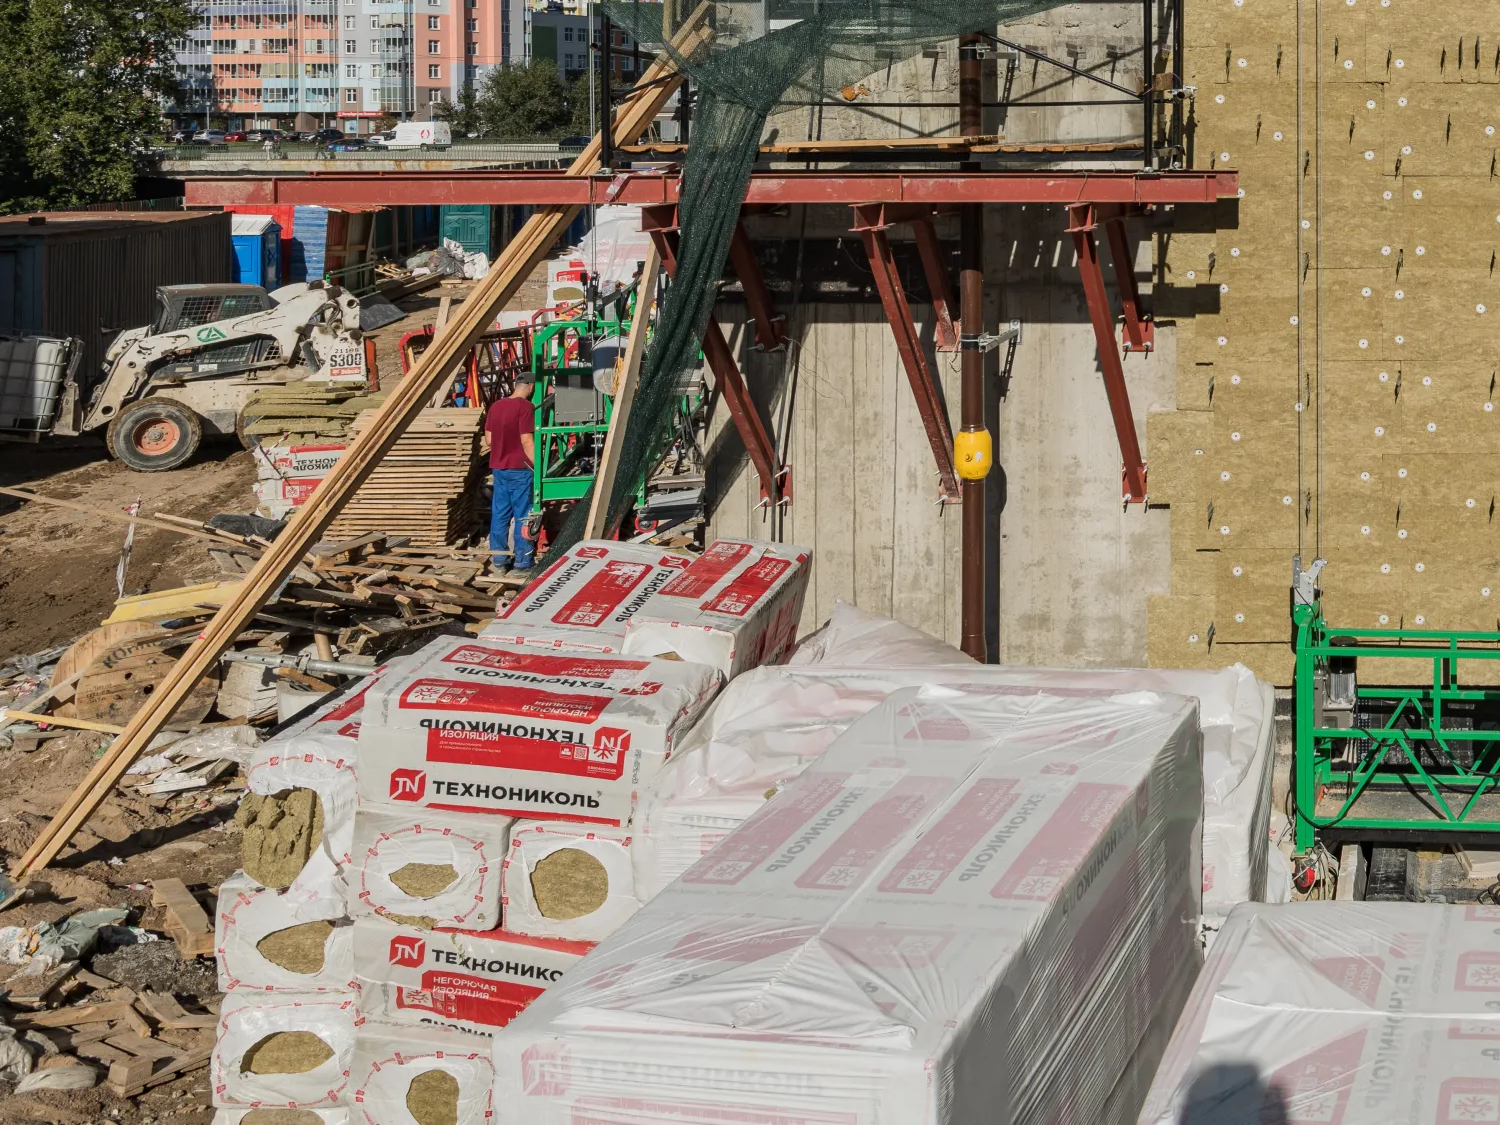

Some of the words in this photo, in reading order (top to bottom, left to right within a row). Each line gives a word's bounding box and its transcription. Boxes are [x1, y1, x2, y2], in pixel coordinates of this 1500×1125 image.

[525, 559, 590, 613] ТЕХНОНИКОЛЬ
[615, 569, 674, 622] ТЕХНОНИКОЛЬ
[522, 704, 589, 717] НЕГОРЮЧАЯ
[440, 729, 499, 742] ИЗОЛЯЦИЯ
[432, 780, 600, 809] ТЕХНОНИКОЛЬ
[765, 786, 871, 873] ЕХНОНИКОЛЬ
[958, 792, 1046, 882] ЕХНОНИКОЛЬ
[433, 976, 497, 992] НЕГОРЮЧАЯ
[433, 985, 490, 1000] ИЗОЛЯЦИЯ
